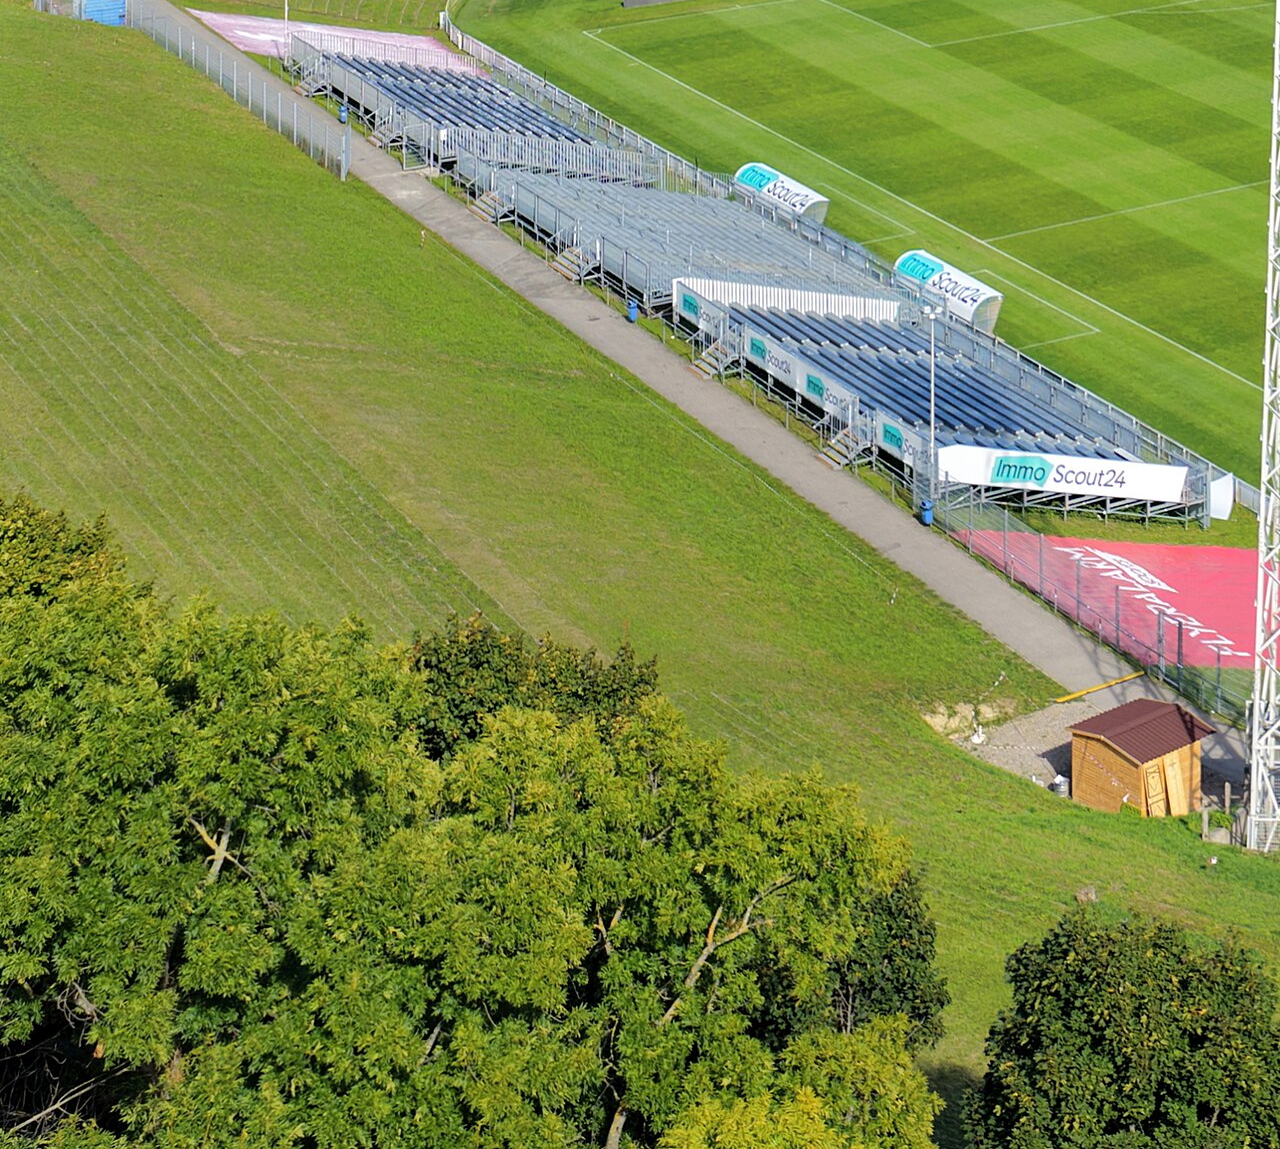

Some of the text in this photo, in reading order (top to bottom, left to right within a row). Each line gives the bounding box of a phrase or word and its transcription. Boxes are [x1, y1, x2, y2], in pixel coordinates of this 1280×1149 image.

[767, 180, 815, 210] Scout24
[932, 271, 987, 307] Scout24
[751, 341, 792, 376] Immo Scout24
[806, 376, 825, 396] Immo
[883, 428, 903, 450] Immo
[996, 458, 1126, 489] Immo Scout24
